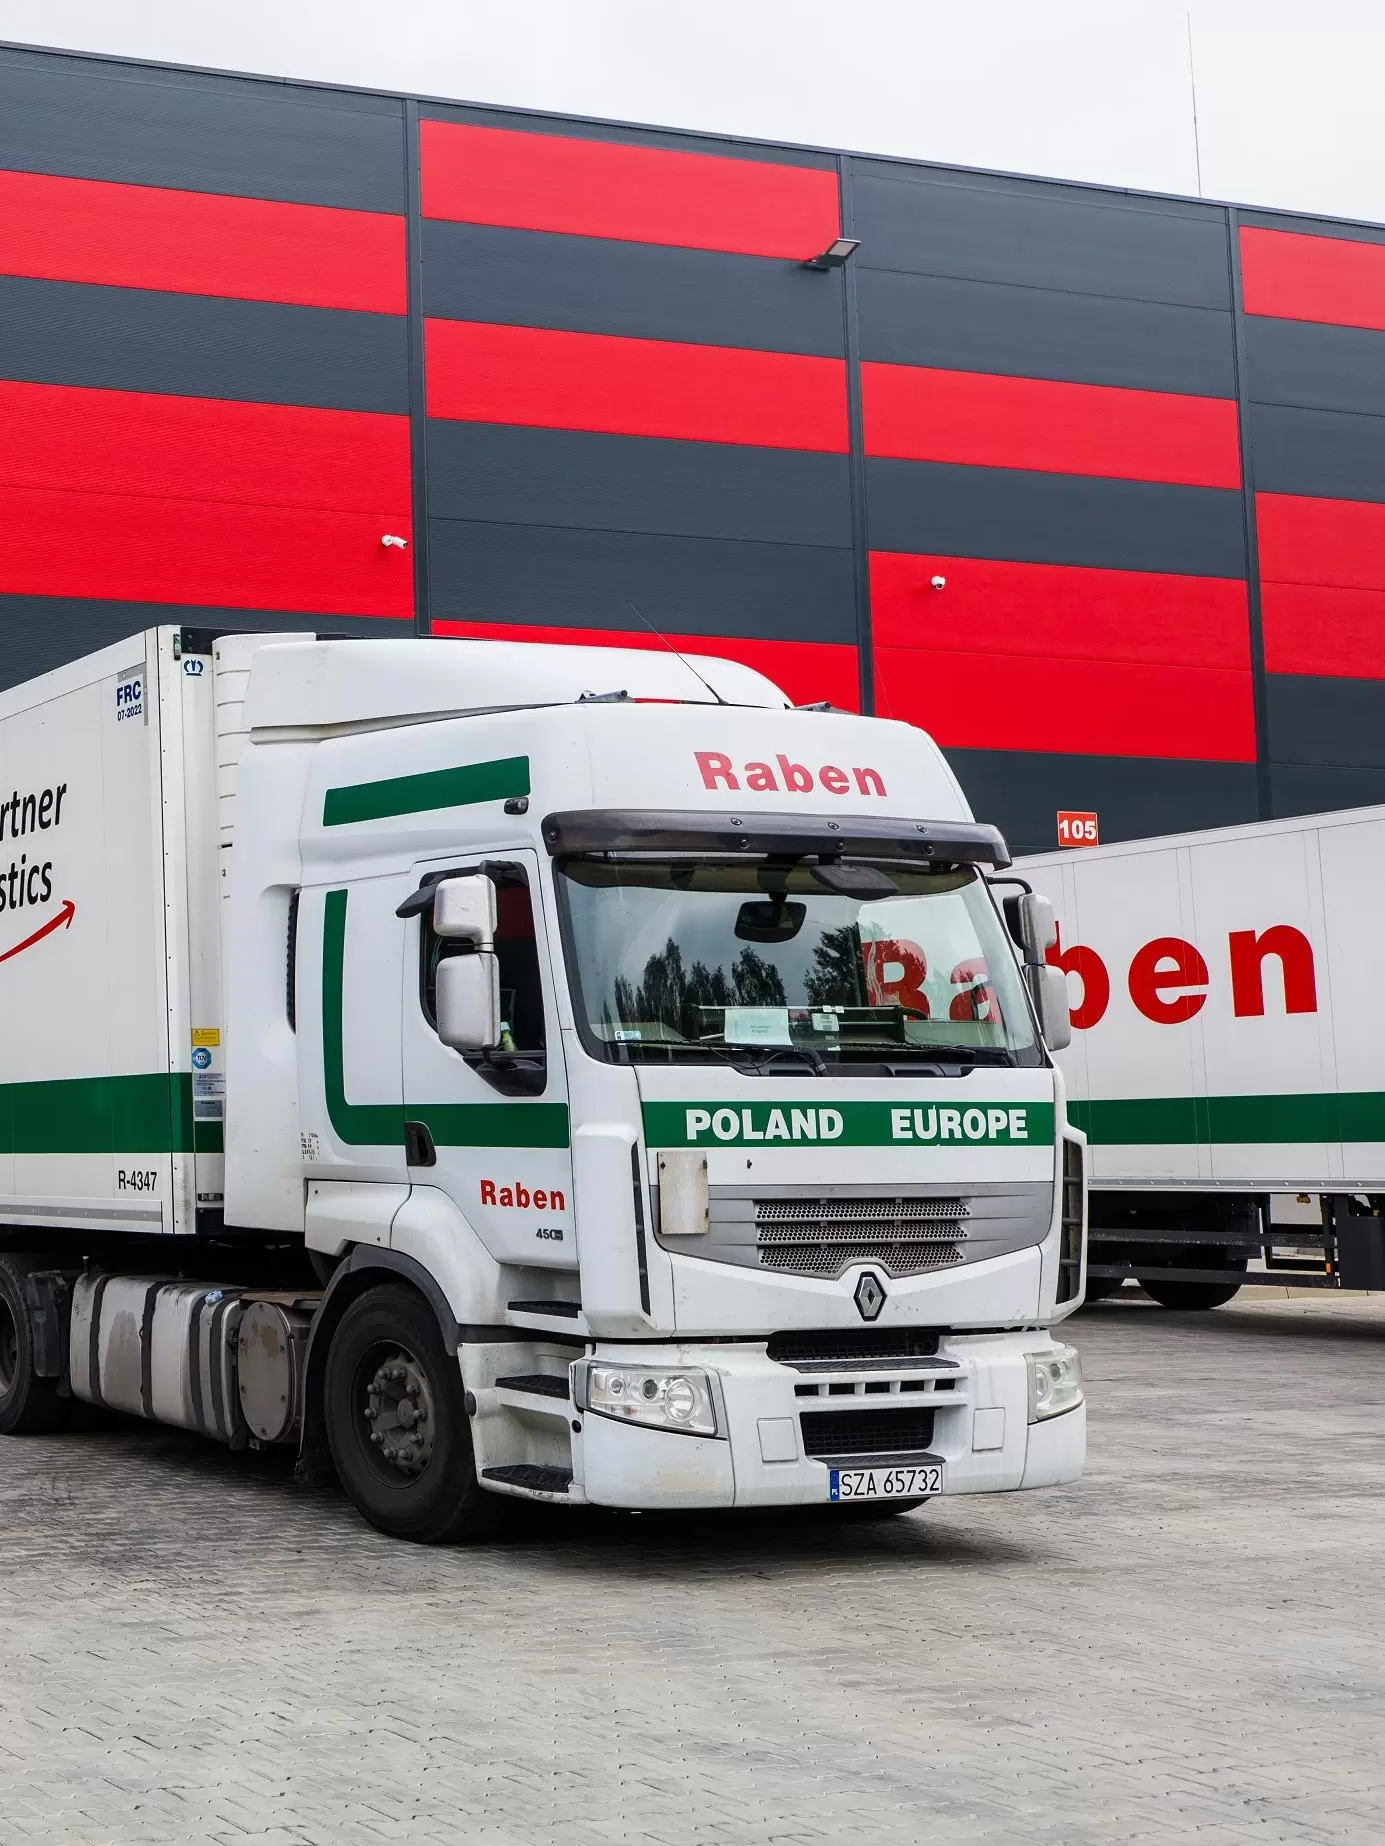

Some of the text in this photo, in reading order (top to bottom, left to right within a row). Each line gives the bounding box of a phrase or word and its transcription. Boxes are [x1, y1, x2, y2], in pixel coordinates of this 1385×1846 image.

[116, 680, 142, 707] FRC
[117, 703, 143, 721] 07-2022
[695, 751, 888, 797] Raben
[1060, 820, 1096, 840] 105
[685, 1105, 1028, 1141] POLAND EUROPE
[118, 1169, 158, 1192] R-4347
[480, 1179, 565, 1211] Raben
[841, 1472, 877, 1497] SZA
[883, 1468, 940, 1494] 65732
